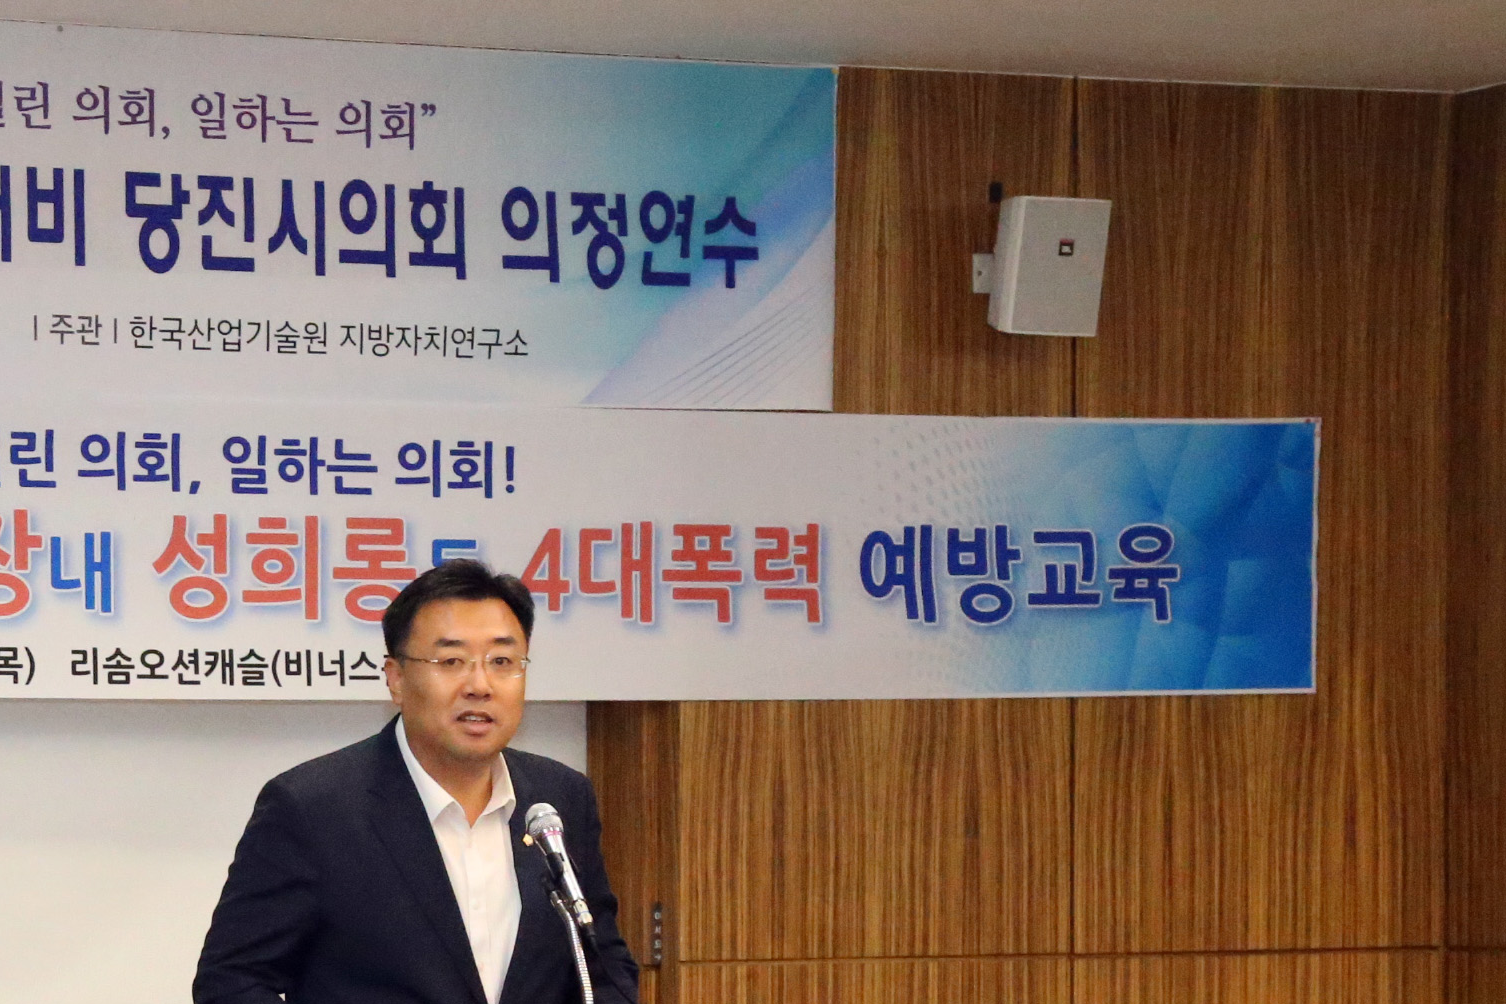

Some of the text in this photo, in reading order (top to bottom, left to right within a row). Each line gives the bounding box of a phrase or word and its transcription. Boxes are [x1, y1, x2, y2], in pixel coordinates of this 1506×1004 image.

[71, 84, 171, 141] 의회,
[189, 91, 320, 145] 일하는
[124, 171, 467, 281] 당진시의회
[500, 185, 760, 290] 의정연수
[129, 316, 328, 355] 한국산업기술원
[339, 322, 530, 360] 지방자치연구소
[77, 431, 202, 496] 의회,
[222, 435, 379, 496] 일하는
[395, 439, 516, 499] 의회!
[518, 520, 822, 625] 4대폭력
[859, 523, 1181, 625] 예방교육
[70, 645, 391, 688] 리솜오션캐슬(비너스
